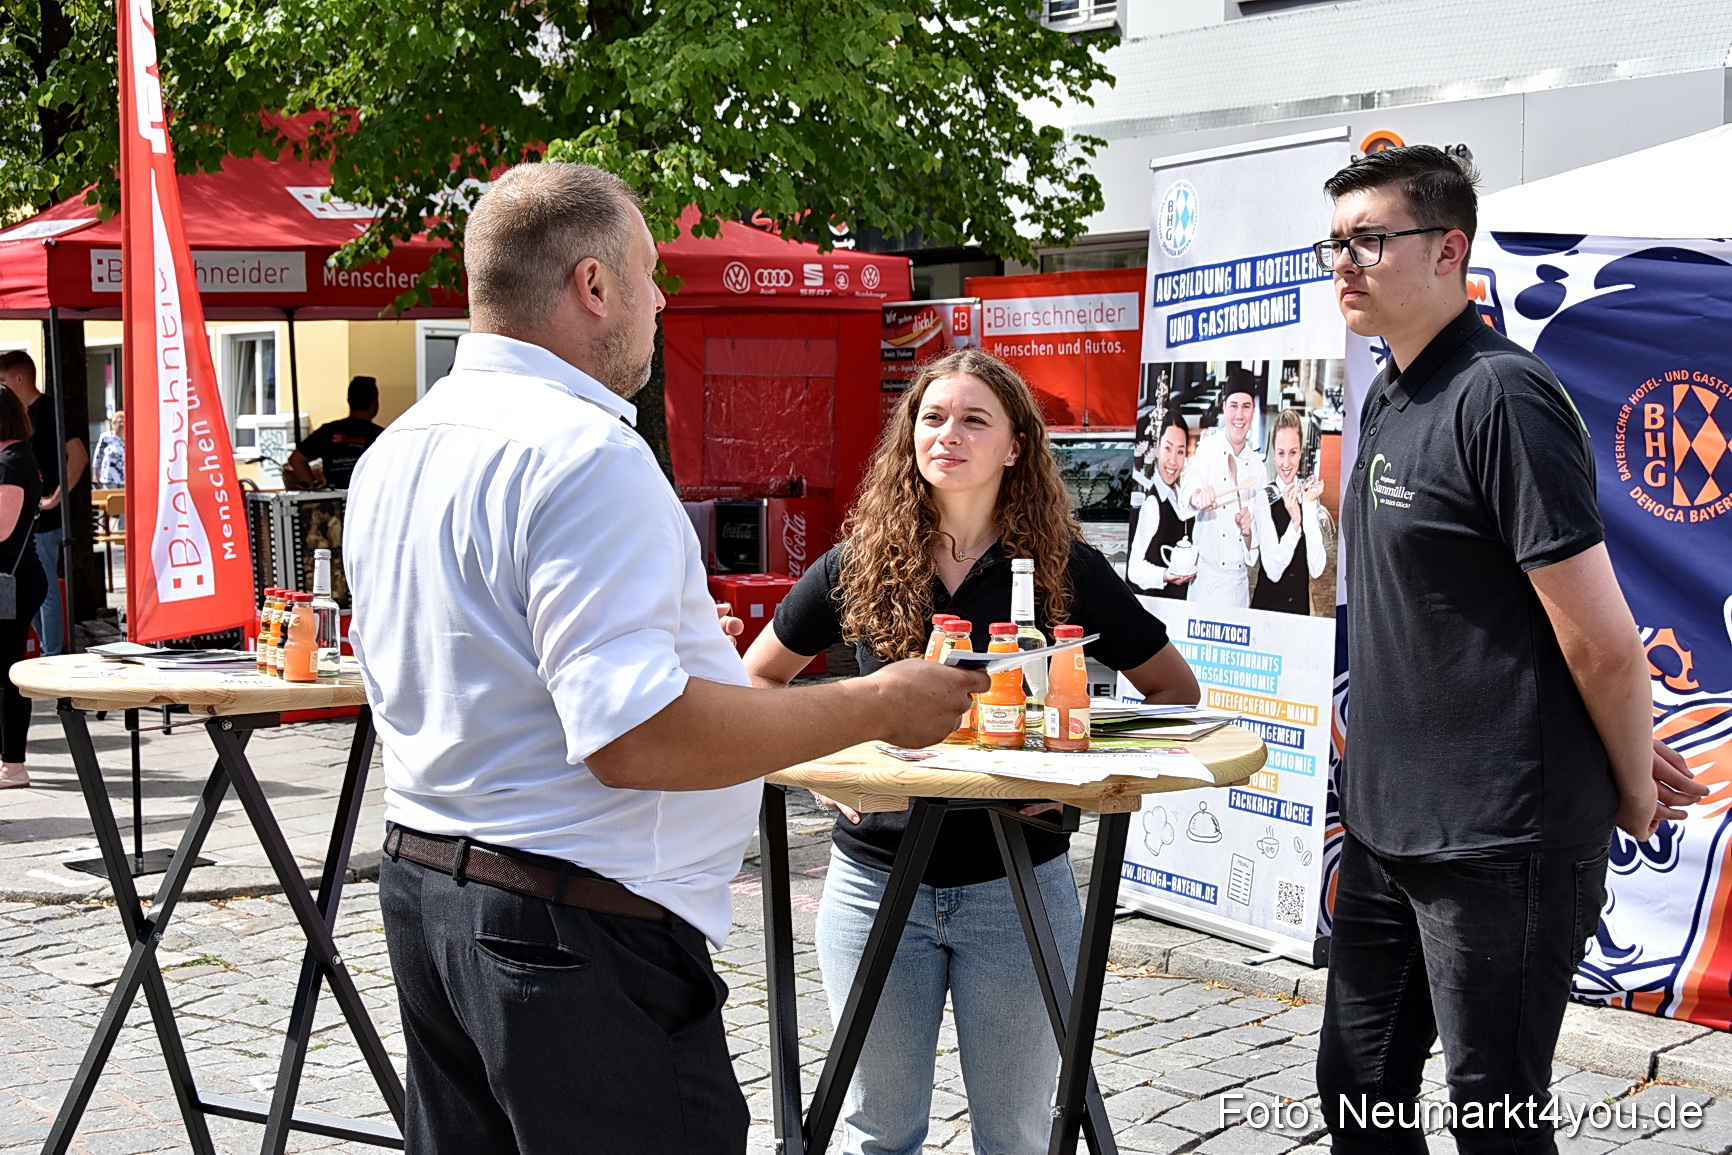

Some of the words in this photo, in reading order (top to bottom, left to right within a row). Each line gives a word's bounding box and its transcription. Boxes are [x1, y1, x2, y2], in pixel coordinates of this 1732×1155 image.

[1156, 265, 1232, 303] AUSBILDUNG
[1235, 261, 1251, 290] IN
[912, 311, 934, 333] dich!
[1169, 314, 1193, 344] UND
[1198, 293, 1297, 336] GASTRONOMIE
[994, 340, 1053, 357] Menschen
[1057, 338, 1081, 355] und
[1085, 339, 1126, 354] Autos.
[1615, 404, 1633, 481] BAYERISCHER
[1629, 378, 1663, 405] HOTEL-
[1664, 370, 1690, 382] UND
[1692, 371, 1732, 400] GASTST
[1101, 442, 1135, 450] TE
[1643, 403, 1667, 487] BHG
[191, 419, 238, 560] Menschen
[1629, 486, 1685, 523] DEHOGA
[1189, 620, 1248, 643] KÖCHIN/KOCH
[1201, 645, 1219, 664] FÜR
[1221, 649, 1279, 672] RESTAURANTS
[1265, 750, 1313, 774] RONOMIE
[1231, 791, 1278, 816] FACHKRAFT
[1280, 801, 1310, 823] KÜCHE
